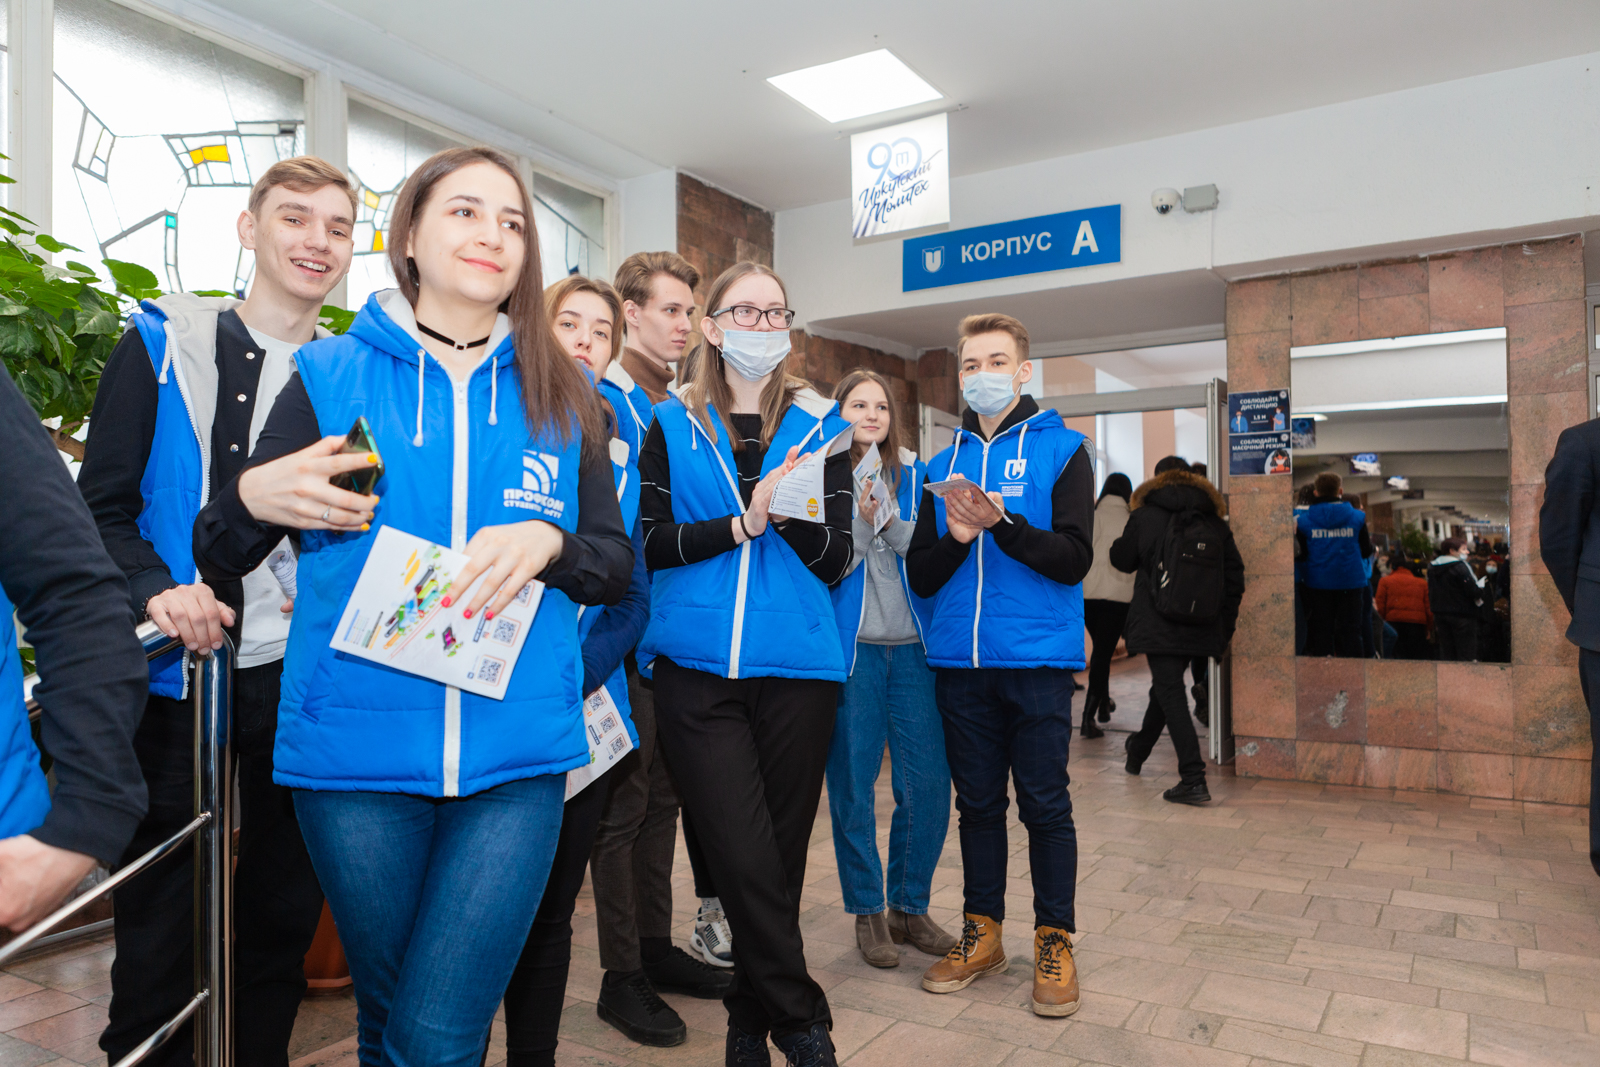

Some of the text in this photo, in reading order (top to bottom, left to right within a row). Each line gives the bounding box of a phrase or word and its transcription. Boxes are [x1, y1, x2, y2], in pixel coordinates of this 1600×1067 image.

[867, 137, 922, 185] 90
[961, 231, 1053, 264] КОРПУС
[1240, 396, 1279, 405] СОБЛЮДАЙТЕ
[1241, 402, 1278, 411] ДИСТАНЦИЮ
[1240, 437, 1278, 445] СОБЛЮДАЙТЕ
[1232, 443, 1265, 451] МАСОЧНЫЙ
[503, 489, 565, 512] ПРОФКОМ
